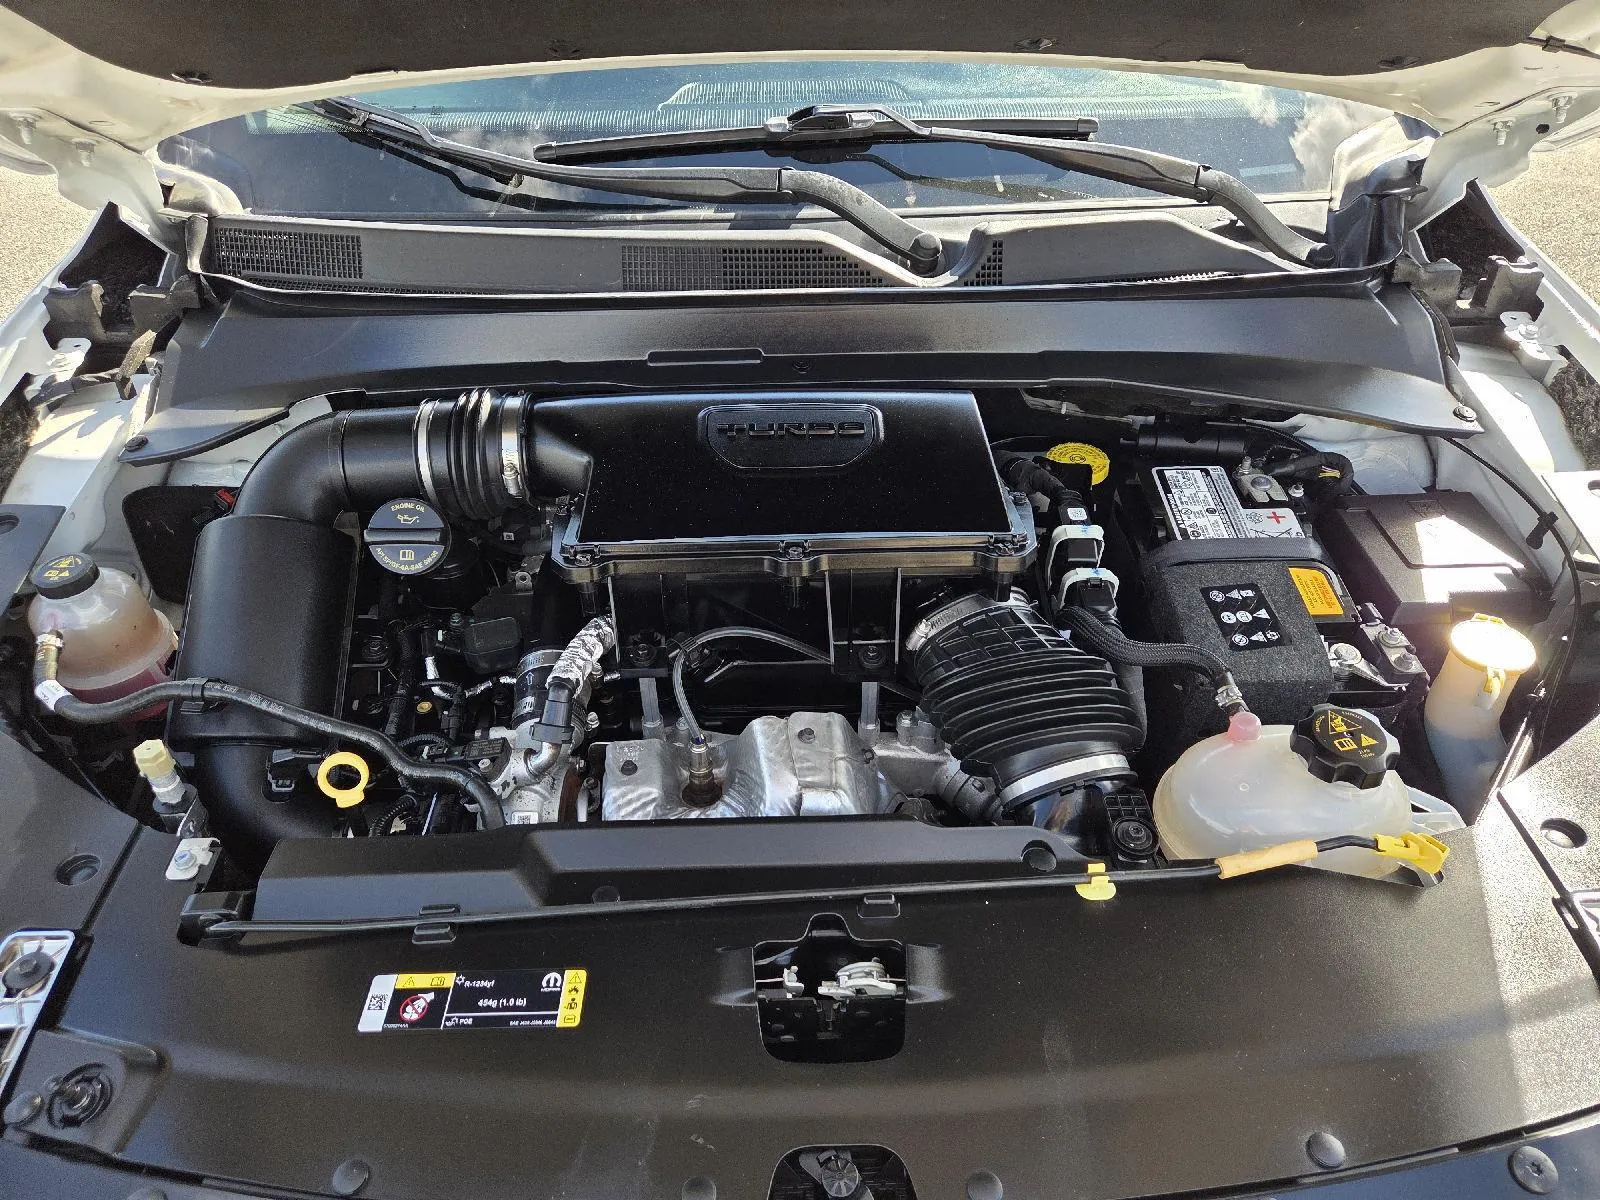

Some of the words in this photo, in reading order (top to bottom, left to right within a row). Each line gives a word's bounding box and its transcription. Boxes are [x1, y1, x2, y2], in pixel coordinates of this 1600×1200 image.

[390, 502, 415, 512] ENGINE
[415, 504, 425, 513] OIL
[477, 998, 498, 1008] 454g
[499, 998, 515, 1008] (1.0
[515, 997, 527, 1006] lb)
